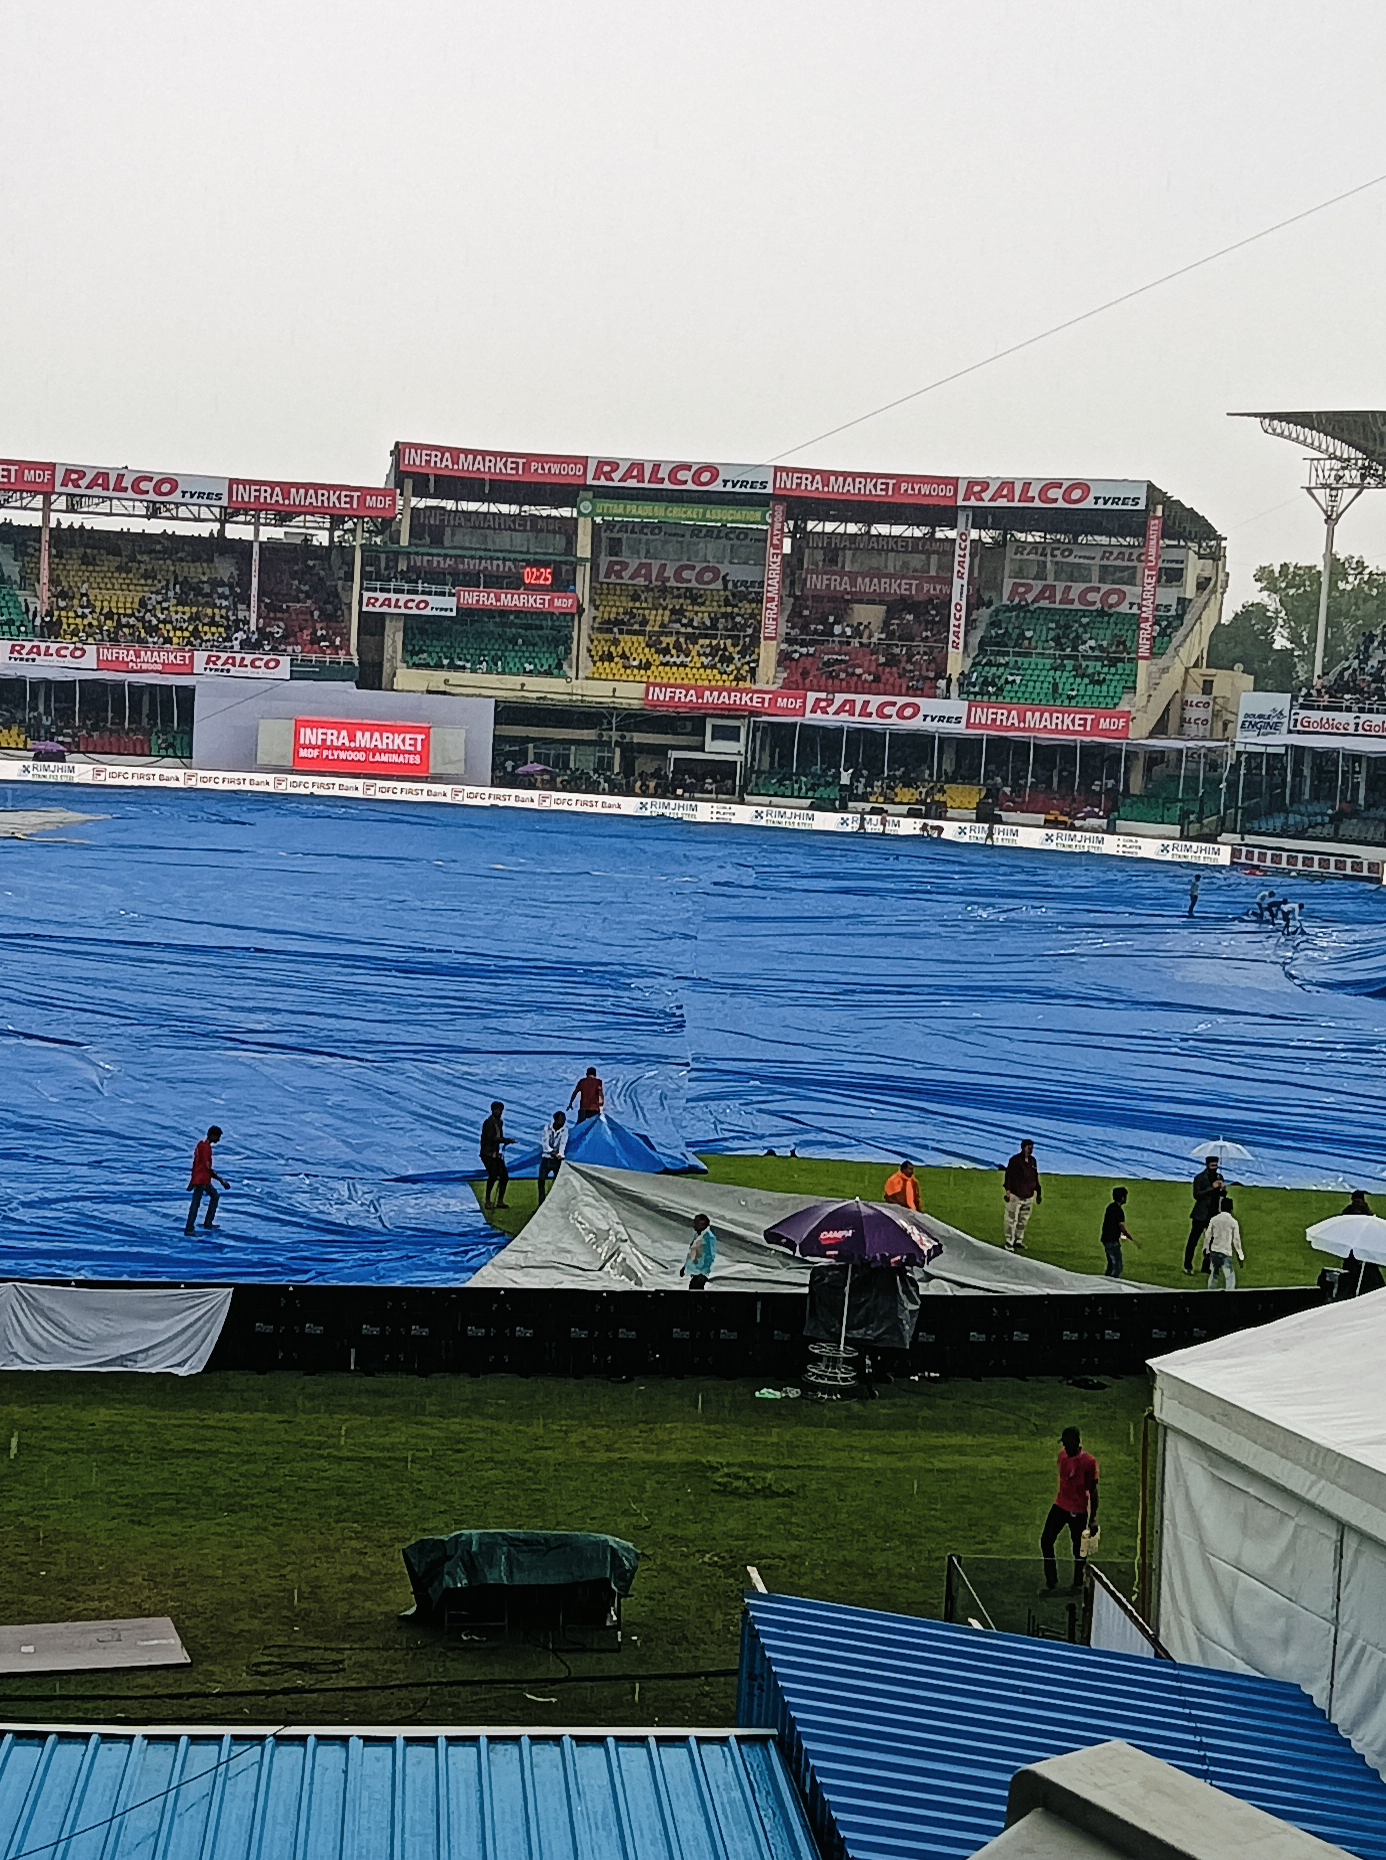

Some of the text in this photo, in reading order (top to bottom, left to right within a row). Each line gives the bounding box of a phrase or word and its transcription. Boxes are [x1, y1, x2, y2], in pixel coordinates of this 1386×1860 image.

[404, 448, 584, 476] INFRA.MARKET PLYWOOD
[24, 469, 53, 483] MDF
[591, 459, 768, 490] RALCO TYRES
[60, 468, 223, 502] RALCO TYRES
[775, 471, 954, 497] INFRA.MARKET PLYWOOD
[962, 480, 1140, 506] RALCO TYRES
[232, 483, 393, 510] INFRA.MARKET MDF
[603, 523, 663, 536] RALCO
[689, 528, 749, 541] RALCO
[956, 531, 969, 580] RALCO
[1014, 545, 1074, 558] RALCO
[523, 568, 552, 585] 02:25
[603, 559, 721, 586] RALCO
[764, 504, 784, 637] INFRA.MARKET PLYWOOD
[806, 574, 919, 595] INFRA.MARKET
[1137, 519, 1159, 657] INFRA.MARKET LAMINATES
[365, 596, 430, 611] RALCO
[459, 591, 573, 609] INFRA.MARKET MDF
[1006, 582, 1127, 608] RALCO
[951, 601, 963, 650] RALCO
[8, 643, 87, 659] RALCO
[8, 656, 37, 664] TYRES
[99, 648, 192, 666] INFRA.MARKET
[128, 662, 163, 671] PLYWOOD
[204, 653, 281, 671] RALCO
[648, 686, 803, 710] INFRA.MARKET MDF
[810, 696, 963, 725] RALCO TYRES
[970, 708, 1127, 731] INFRA.MARKET MDF
[299, 727, 425, 752] INFRA.MARKET
[299, 748, 421, 765] MDF PLYWOOD LAMINATES
[32, 763, 75, 774] RIMJHIM
[131, 772, 157, 782] FIRST
[222, 776, 247, 786] FIRST
[312, 782, 336, 791] FIRST
[575, 798, 599, 808] FIRST
[650, 801, 698, 812] RIMJHIM
[765, 809, 815, 822] RIMJHIM
[1056, 832, 1105, 845] RIMJHIM
[1171, 843, 1221, 857] RIMJHIM
